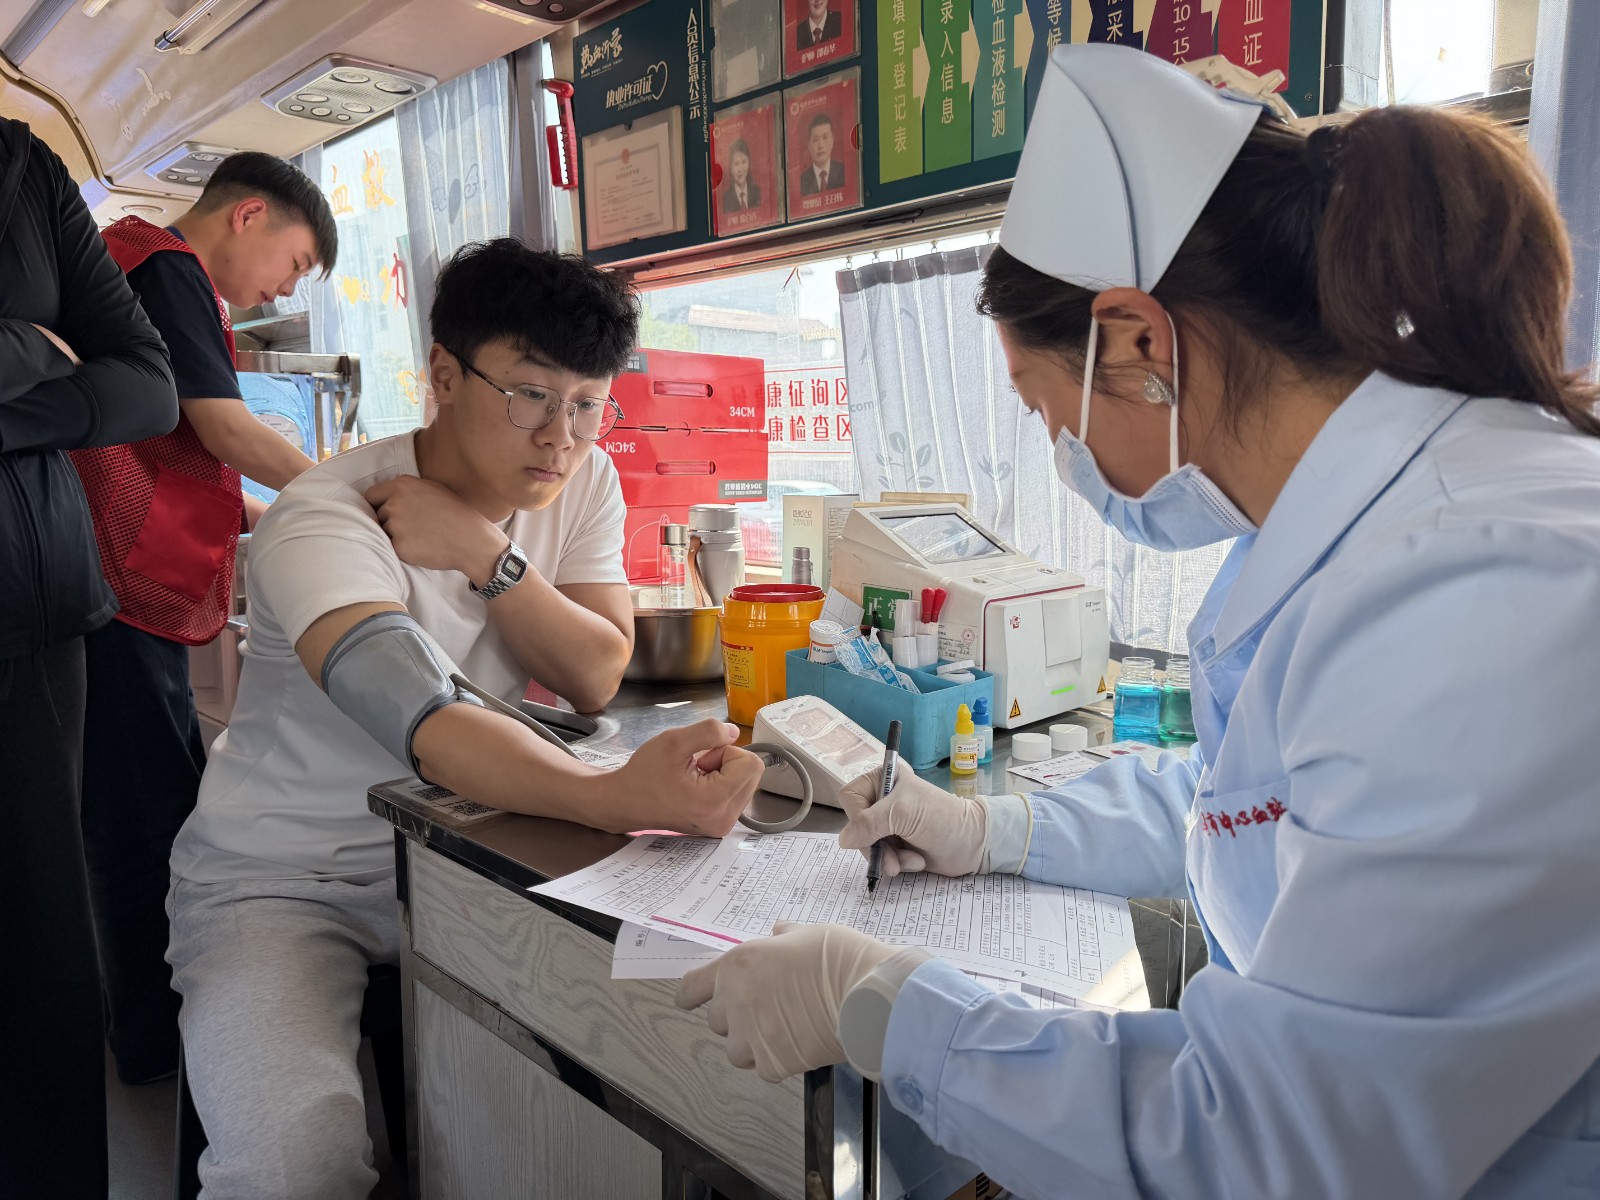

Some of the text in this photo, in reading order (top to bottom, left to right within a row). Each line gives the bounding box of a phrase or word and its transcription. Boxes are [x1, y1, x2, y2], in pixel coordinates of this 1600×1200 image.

[687, 8, 700, 119] 人员信息公示
[893, 0, 907, 153] 填写登记表
[940, 0, 954, 124] 录入信息
[605, 74, 653, 109] 执业许可证
[729, 406, 755, 417] 34CM
[768, 414, 851, 441] 康检查区
[605, 441, 636, 454] 34CM
